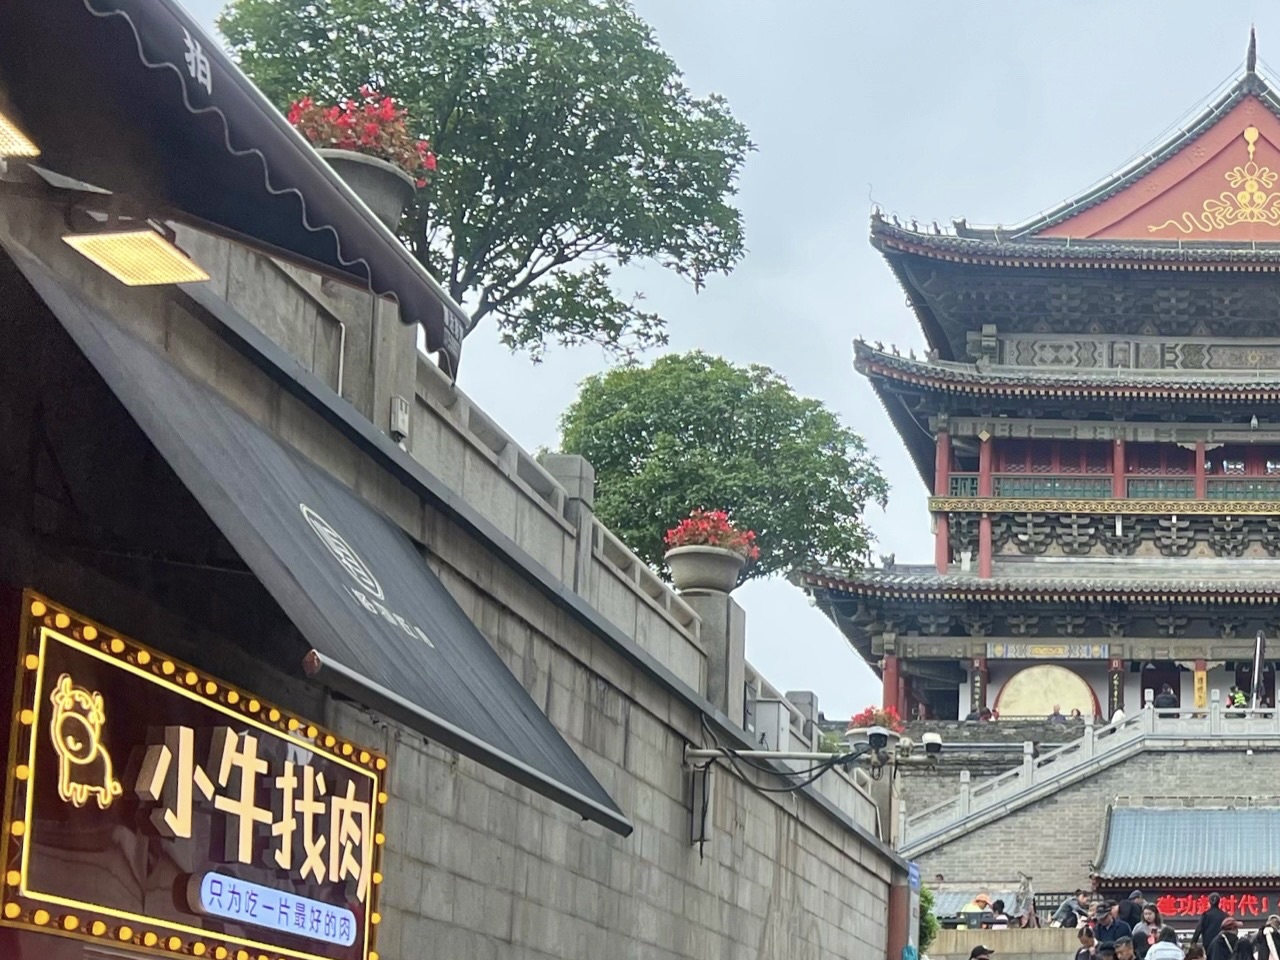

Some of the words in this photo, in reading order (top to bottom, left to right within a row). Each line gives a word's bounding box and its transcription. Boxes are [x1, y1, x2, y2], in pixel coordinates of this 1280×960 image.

[150, 726, 370, 902] 小牛找肉
[209, 879, 351, 942] 只为吃一片最好的肉
